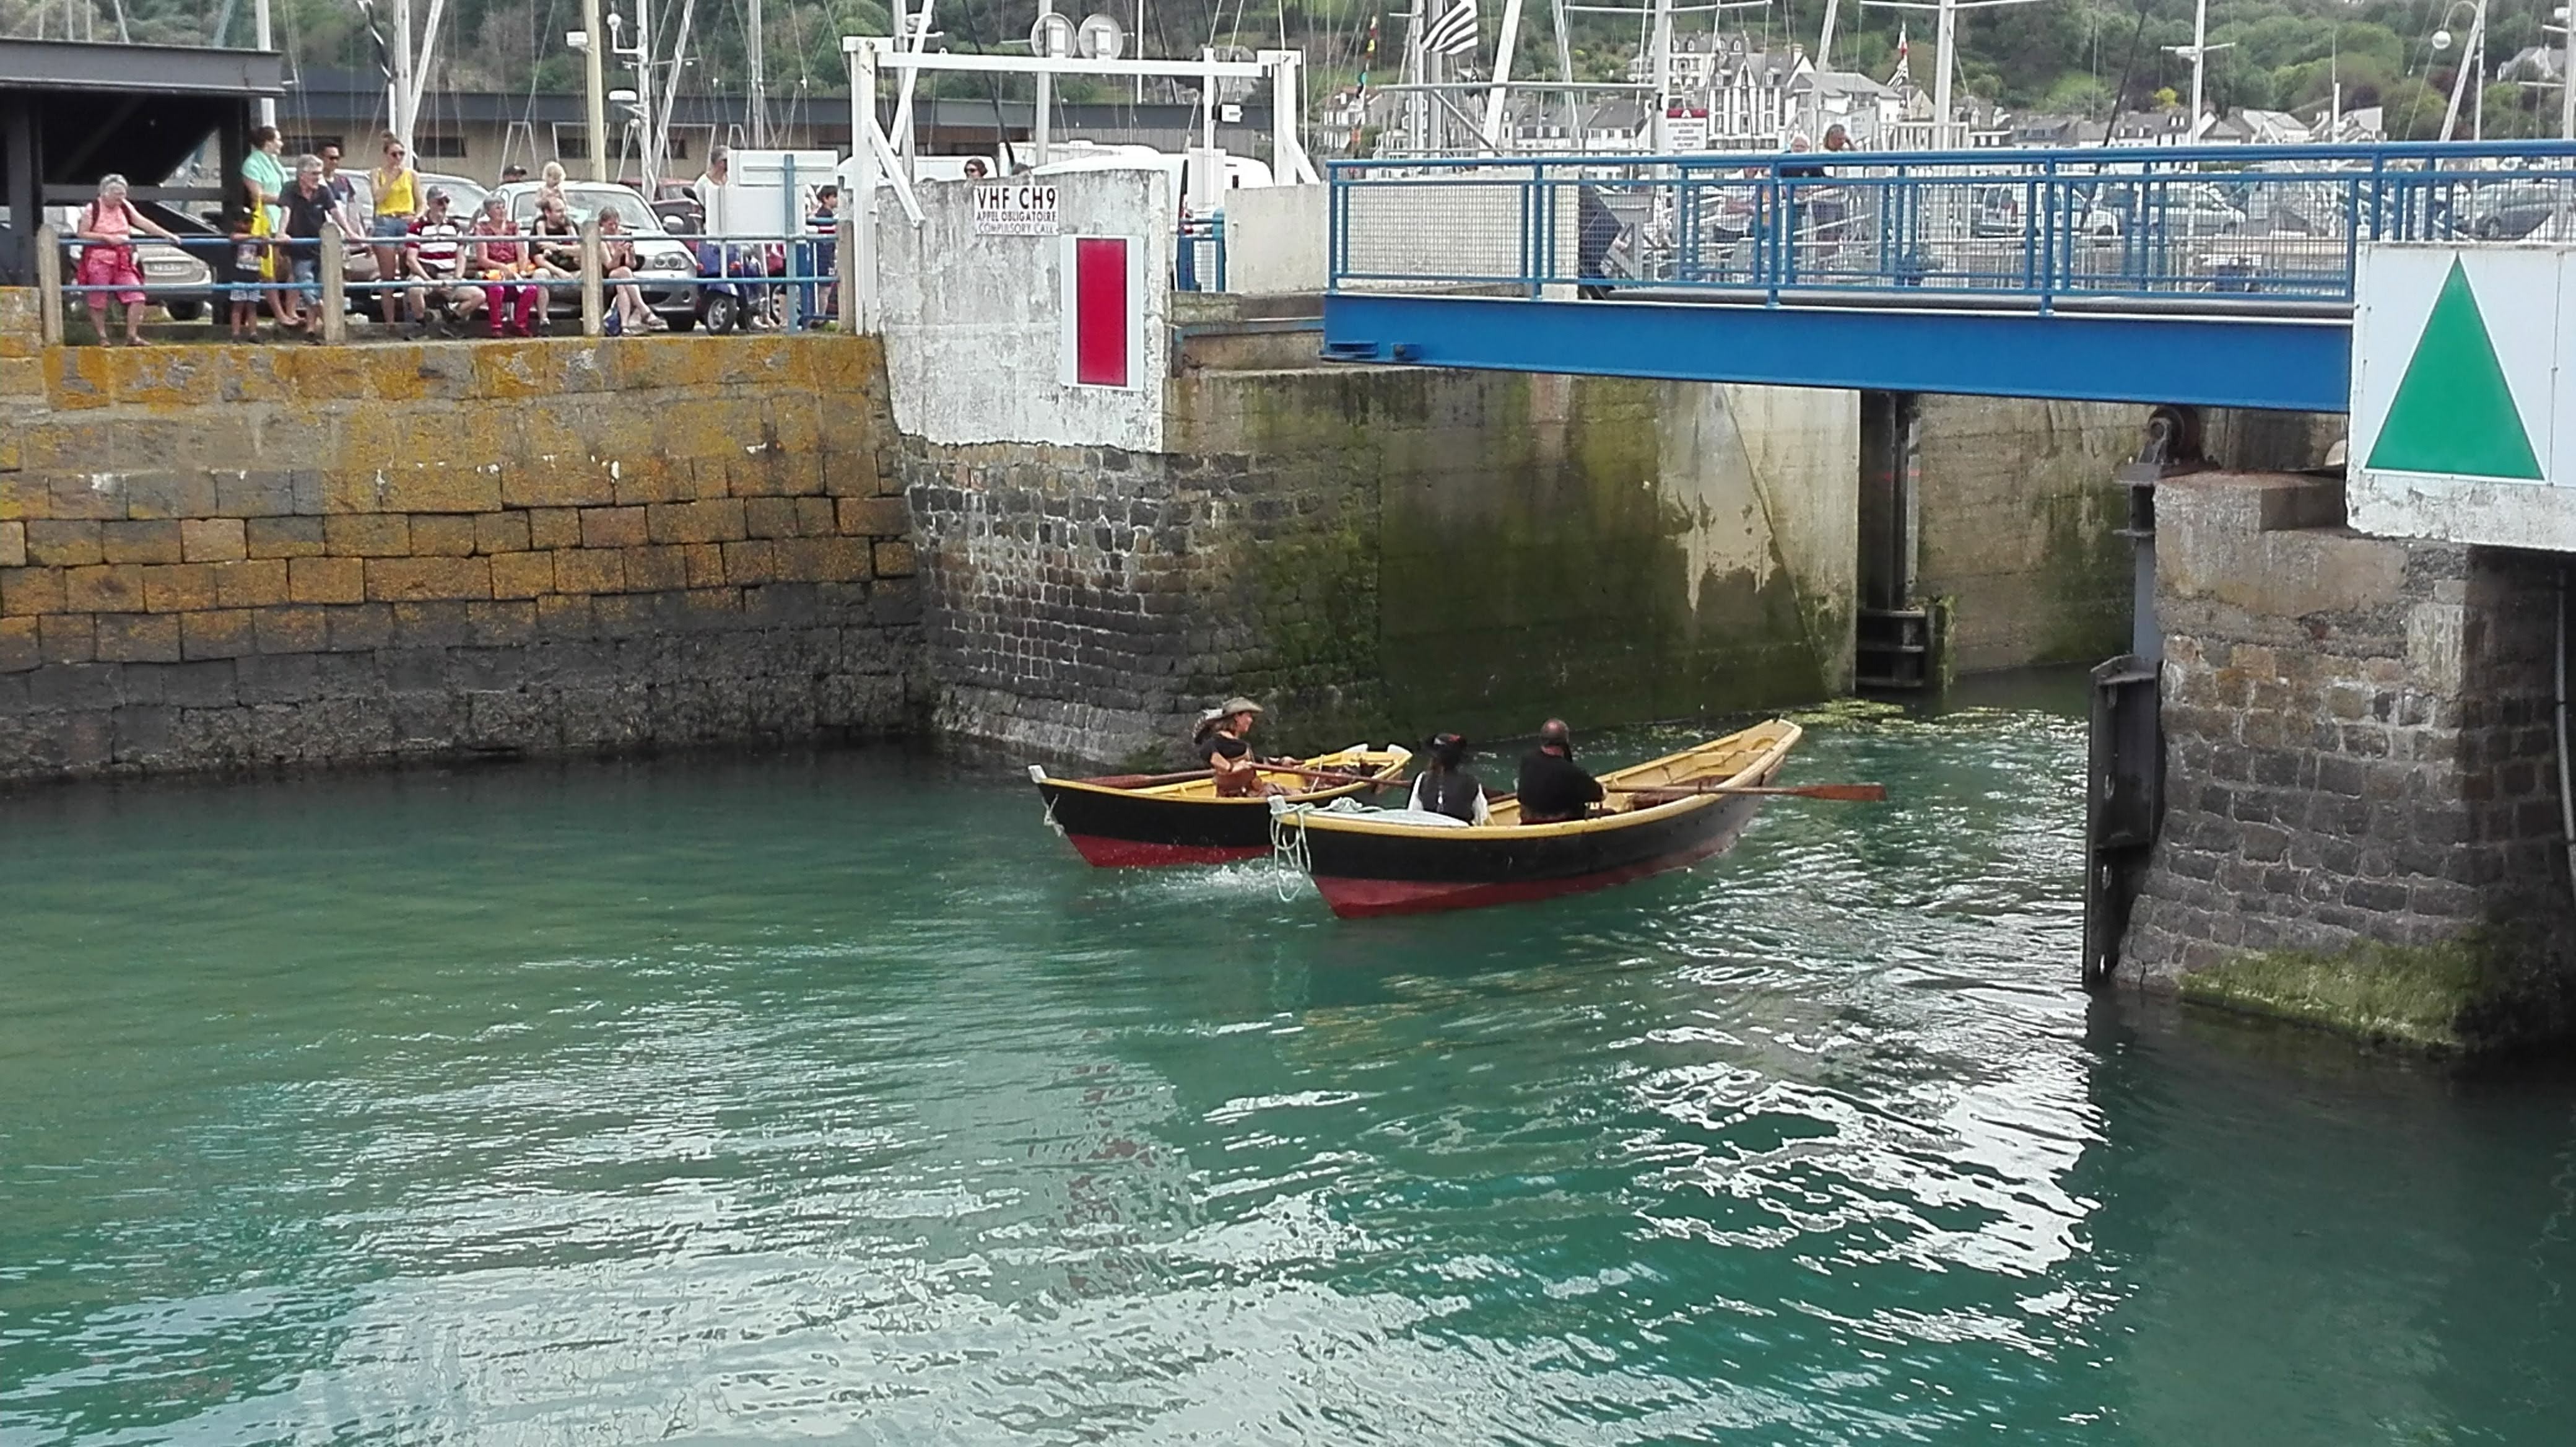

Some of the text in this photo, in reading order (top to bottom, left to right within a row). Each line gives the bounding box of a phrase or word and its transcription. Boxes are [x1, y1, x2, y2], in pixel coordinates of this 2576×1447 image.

[977, 187, 1056, 209] VHF CH9
[976, 211, 1056, 222] APPEL OBLIGATOIRE
[978, 223, 1054, 234] COMPULSORY CALL
